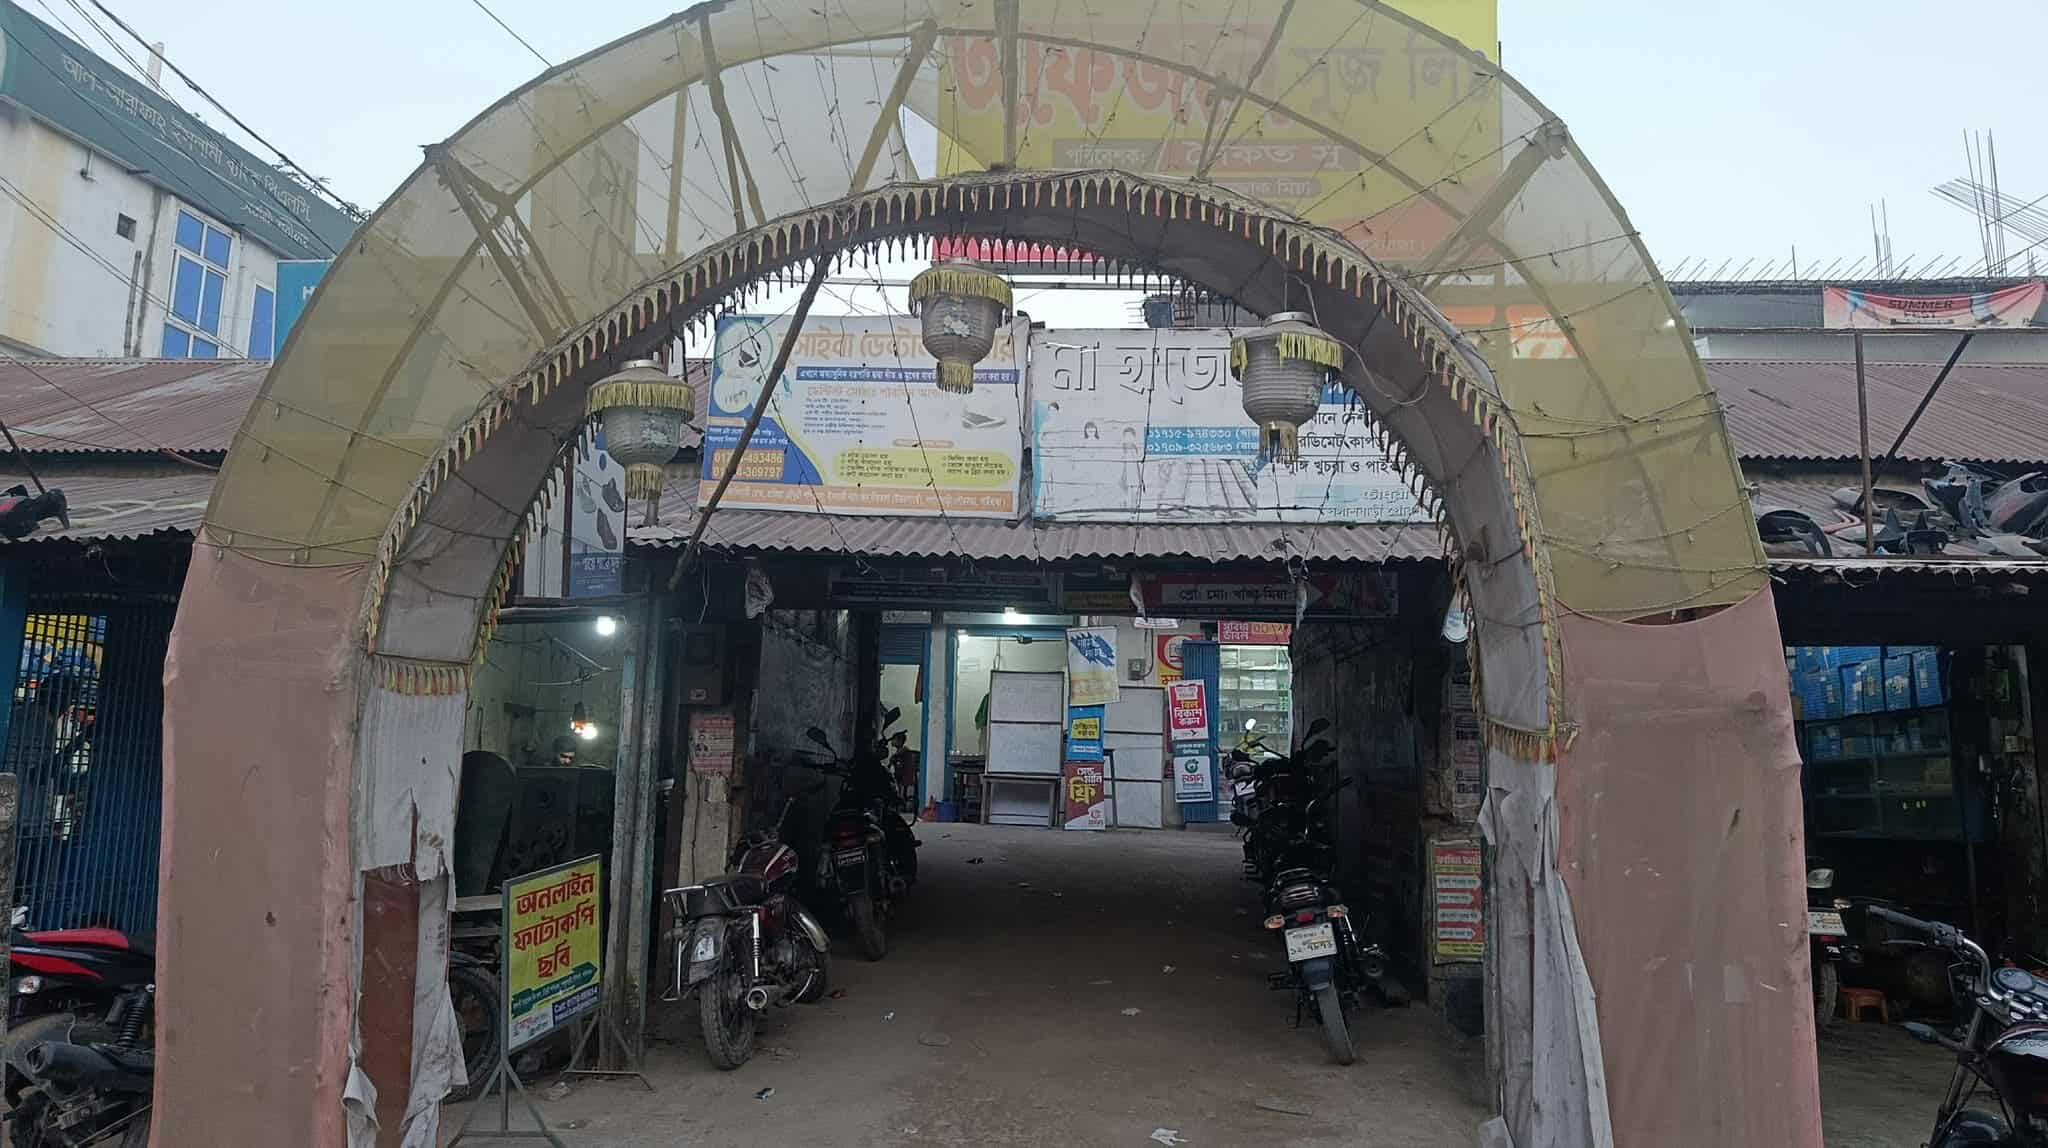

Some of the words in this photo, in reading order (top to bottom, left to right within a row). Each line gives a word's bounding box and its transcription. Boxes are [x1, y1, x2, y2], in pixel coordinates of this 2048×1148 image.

[1887, 299, 1954, 310] SUMMER
[713, 452, 783, 464] 017-483486
[1350, 461, 1361, 472] ও
[515, 871, 596, 916] অনলাইন
[536, 938, 572, 978] ছবি
